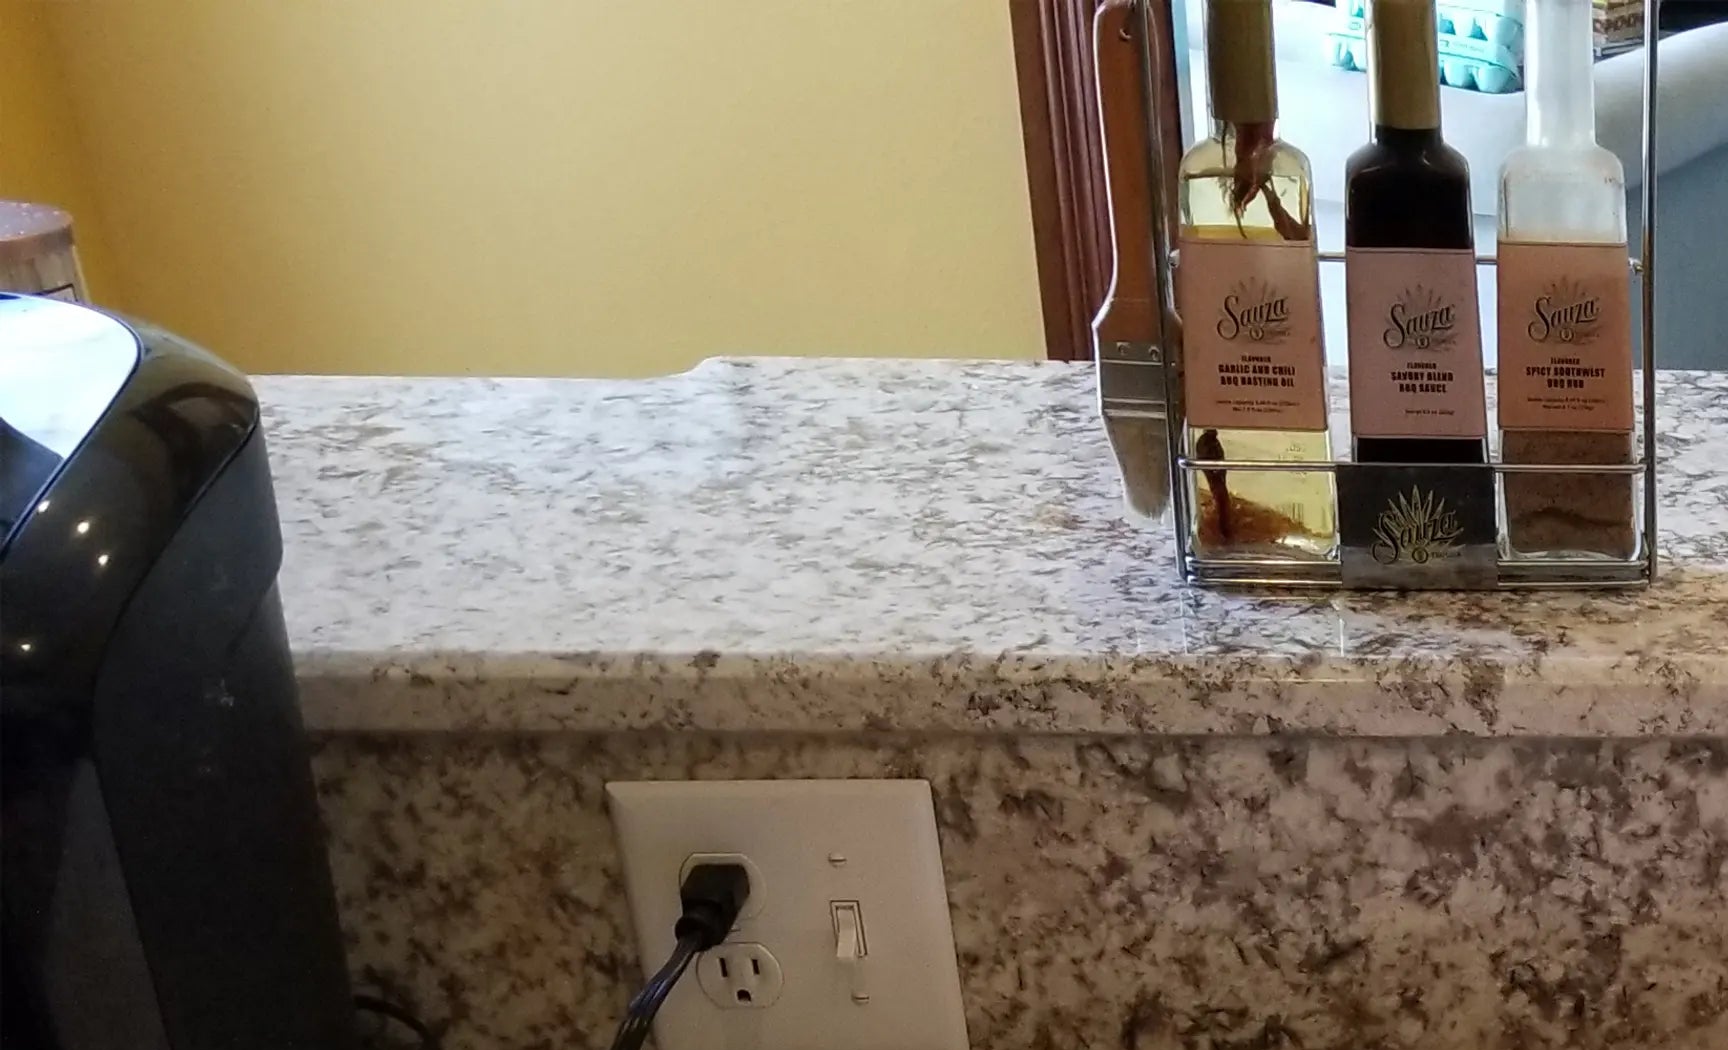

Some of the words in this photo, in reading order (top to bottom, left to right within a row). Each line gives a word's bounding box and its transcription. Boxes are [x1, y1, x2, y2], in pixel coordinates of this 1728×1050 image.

[1217, 295, 1290, 340] Sauza
[1528, 296, 1600, 342] Sauza
[1383, 303, 1456, 349] Sauza
[1218, 364, 1250, 374] GARLIC
[1252, 365, 1270, 375] AND
[1272, 366, 1296, 376] CHILI
[1526, 366, 1551, 376] SPICY
[1553, 366, 1605, 378] SOUTHWEST
[1220, 376, 1238, 386] BBQ
[1280, 378, 1295, 388] OIL
[1391, 371, 1425, 381] SAVORY
[1426, 372, 1454, 382] BLEND
[1399, 383, 1417, 394] BBQ
[1419, 383, 1447, 393] SAUCE
[1371, 510, 1461, 565] Sauza
